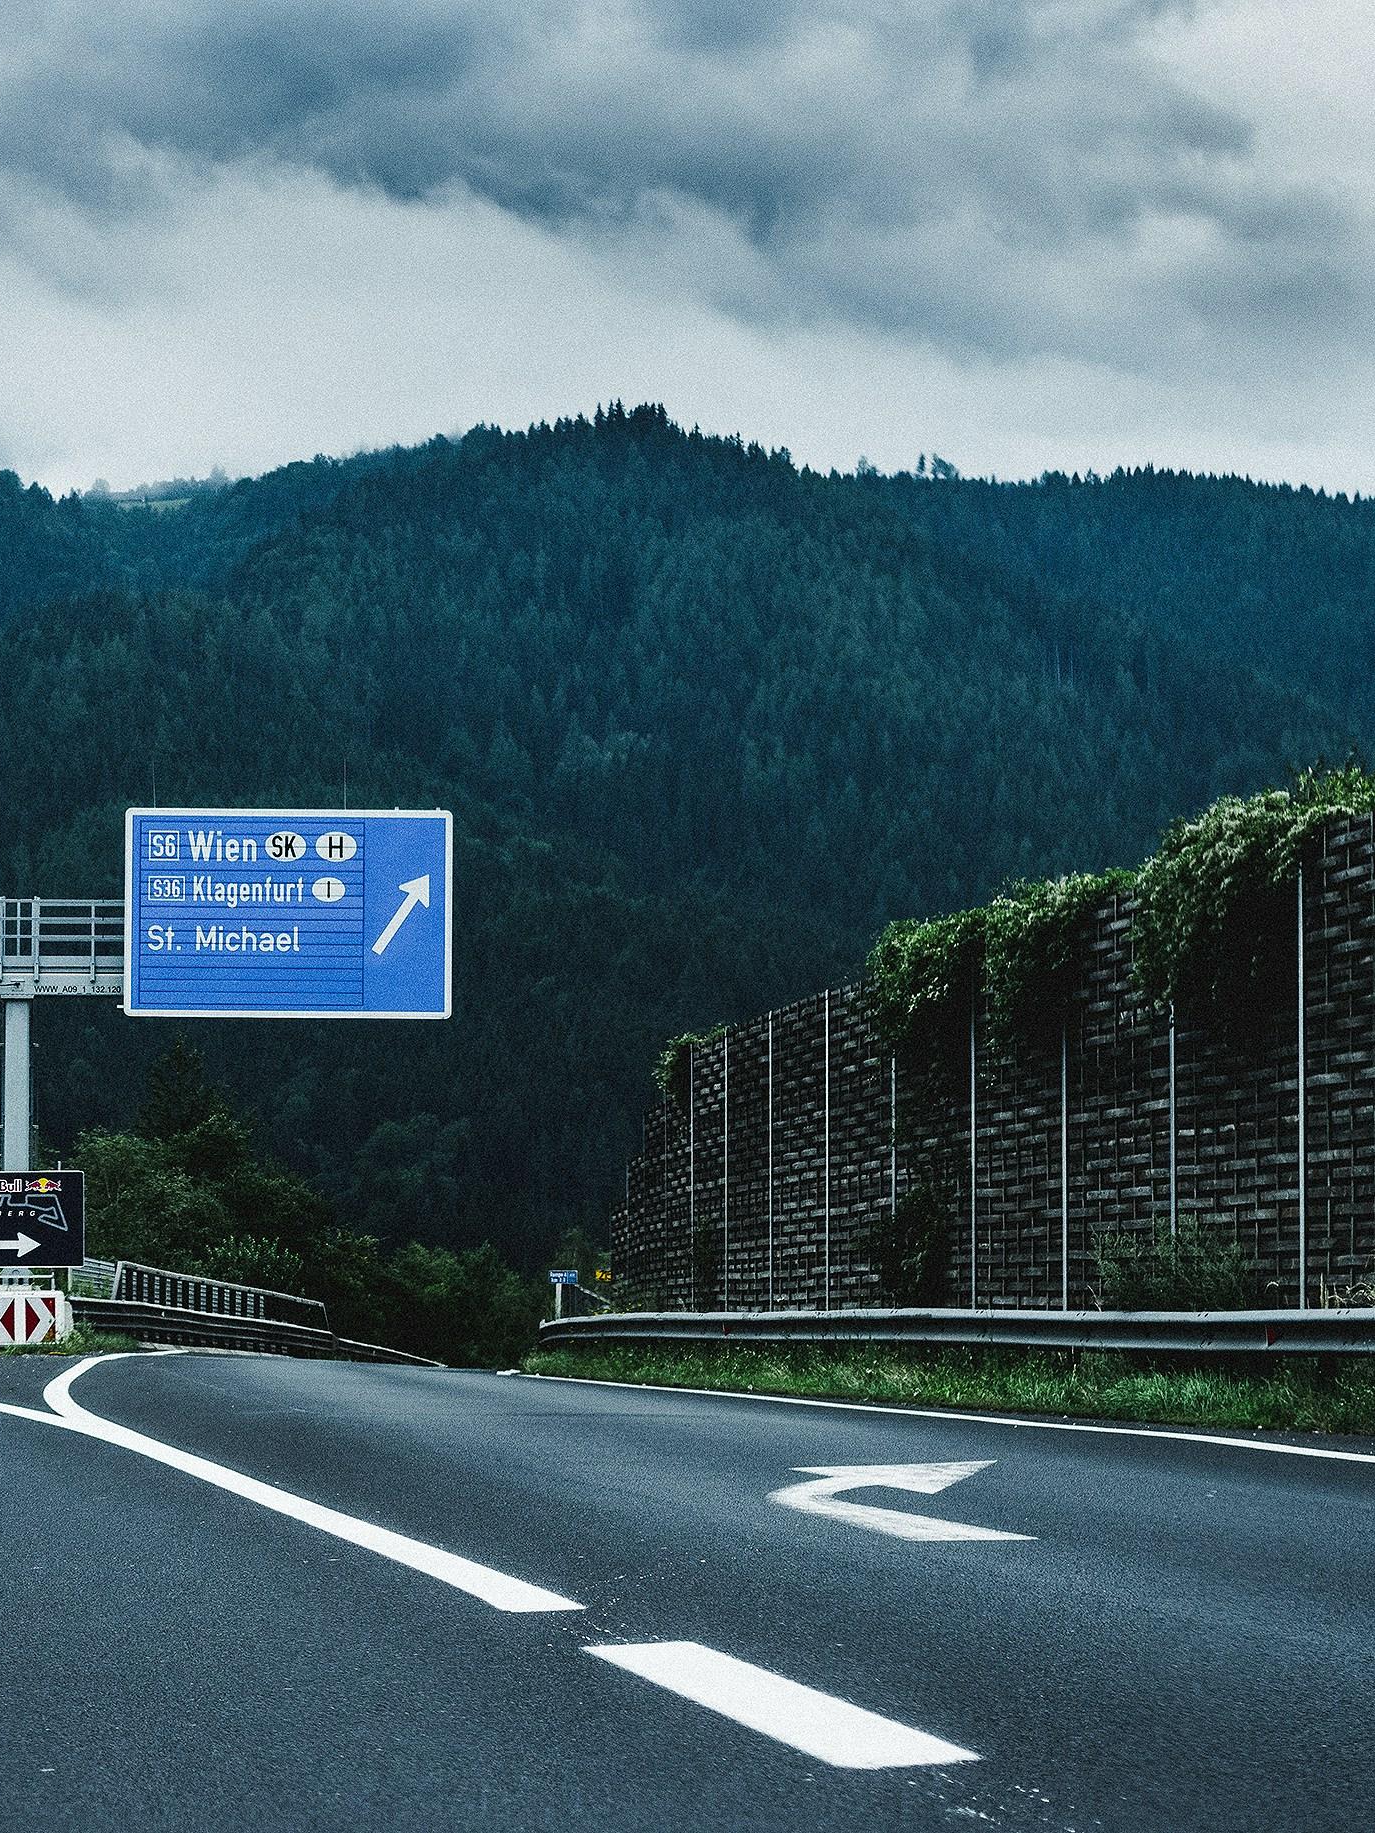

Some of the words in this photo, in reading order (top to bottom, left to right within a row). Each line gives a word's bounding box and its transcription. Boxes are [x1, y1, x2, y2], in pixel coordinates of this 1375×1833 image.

[152, 836, 176, 857] S6
[188, 830, 258, 862] Wien
[271, 835, 297, 858] SK
[328, 836, 344, 859] H
[153, 880, 181, 898] S36
[193, 876, 304, 908] Klagenfurt
[147, 925, 181, 951] St.
[195, 926, 300, 952] Michael
[0, 1179, 23, 1193] Bull
